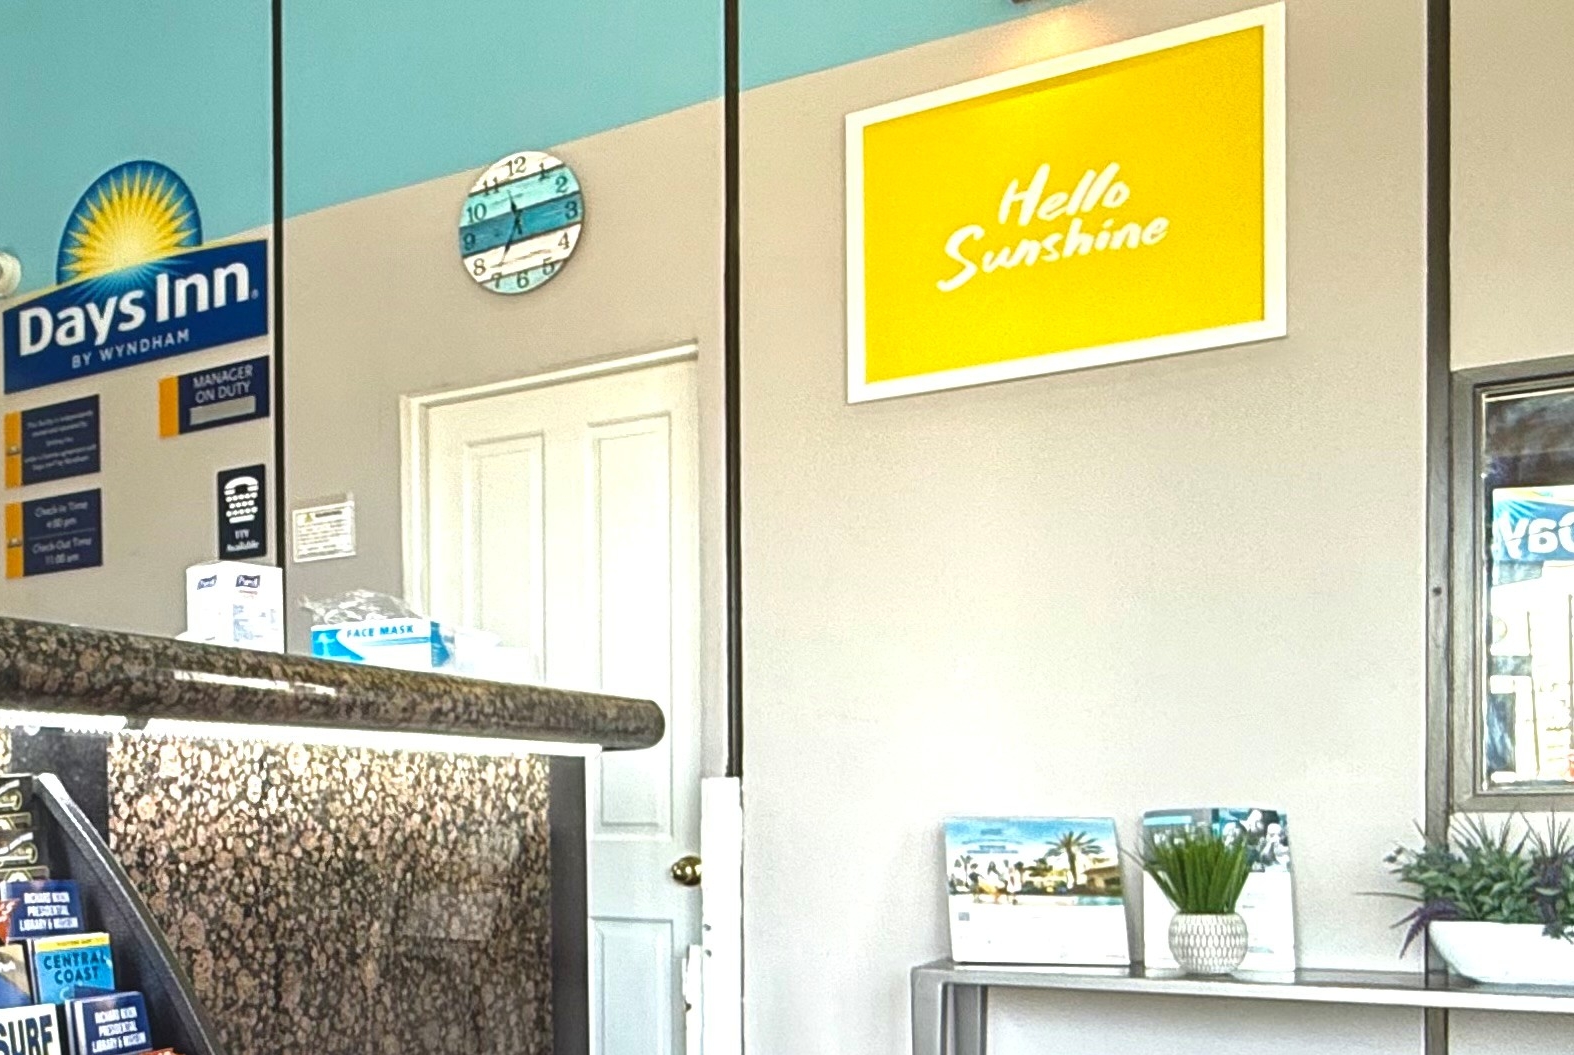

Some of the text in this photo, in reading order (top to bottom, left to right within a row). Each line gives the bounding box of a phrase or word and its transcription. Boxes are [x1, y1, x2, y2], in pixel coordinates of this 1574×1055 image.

[506, 156, 526, 177] 12
[538, 162, 550, 181] 1
[482, 176, 501, 196] 11
[555, 175, 569, 193] 2
[997, 161, 1131, 227] Hello
[467, 203, 487, 224] 10
[564, 201, 578, 220] 3
[462, 232, 476, 251] 9
[558, 232, 570, 250] 4
[936, 216, 1170, 292] Sunshine
[473, 258, 486, 276] 8
[542, 257, 555, 276] 5
[490, 271, 502, 289] 7
[516, 271, 529, 289] 6
[19, 262, 249, 357] Days Inn
[71, 328, 190, 369] BY WYNDHAM
[193, 364, 254, 390] MANAGER
[195, 381, 252, 404] ON DUTY
[346, 624, 415, 639] FACE MASK
[43, 950, 107, 970] CENTRAL
[54, 966, 99, 985] COAST
